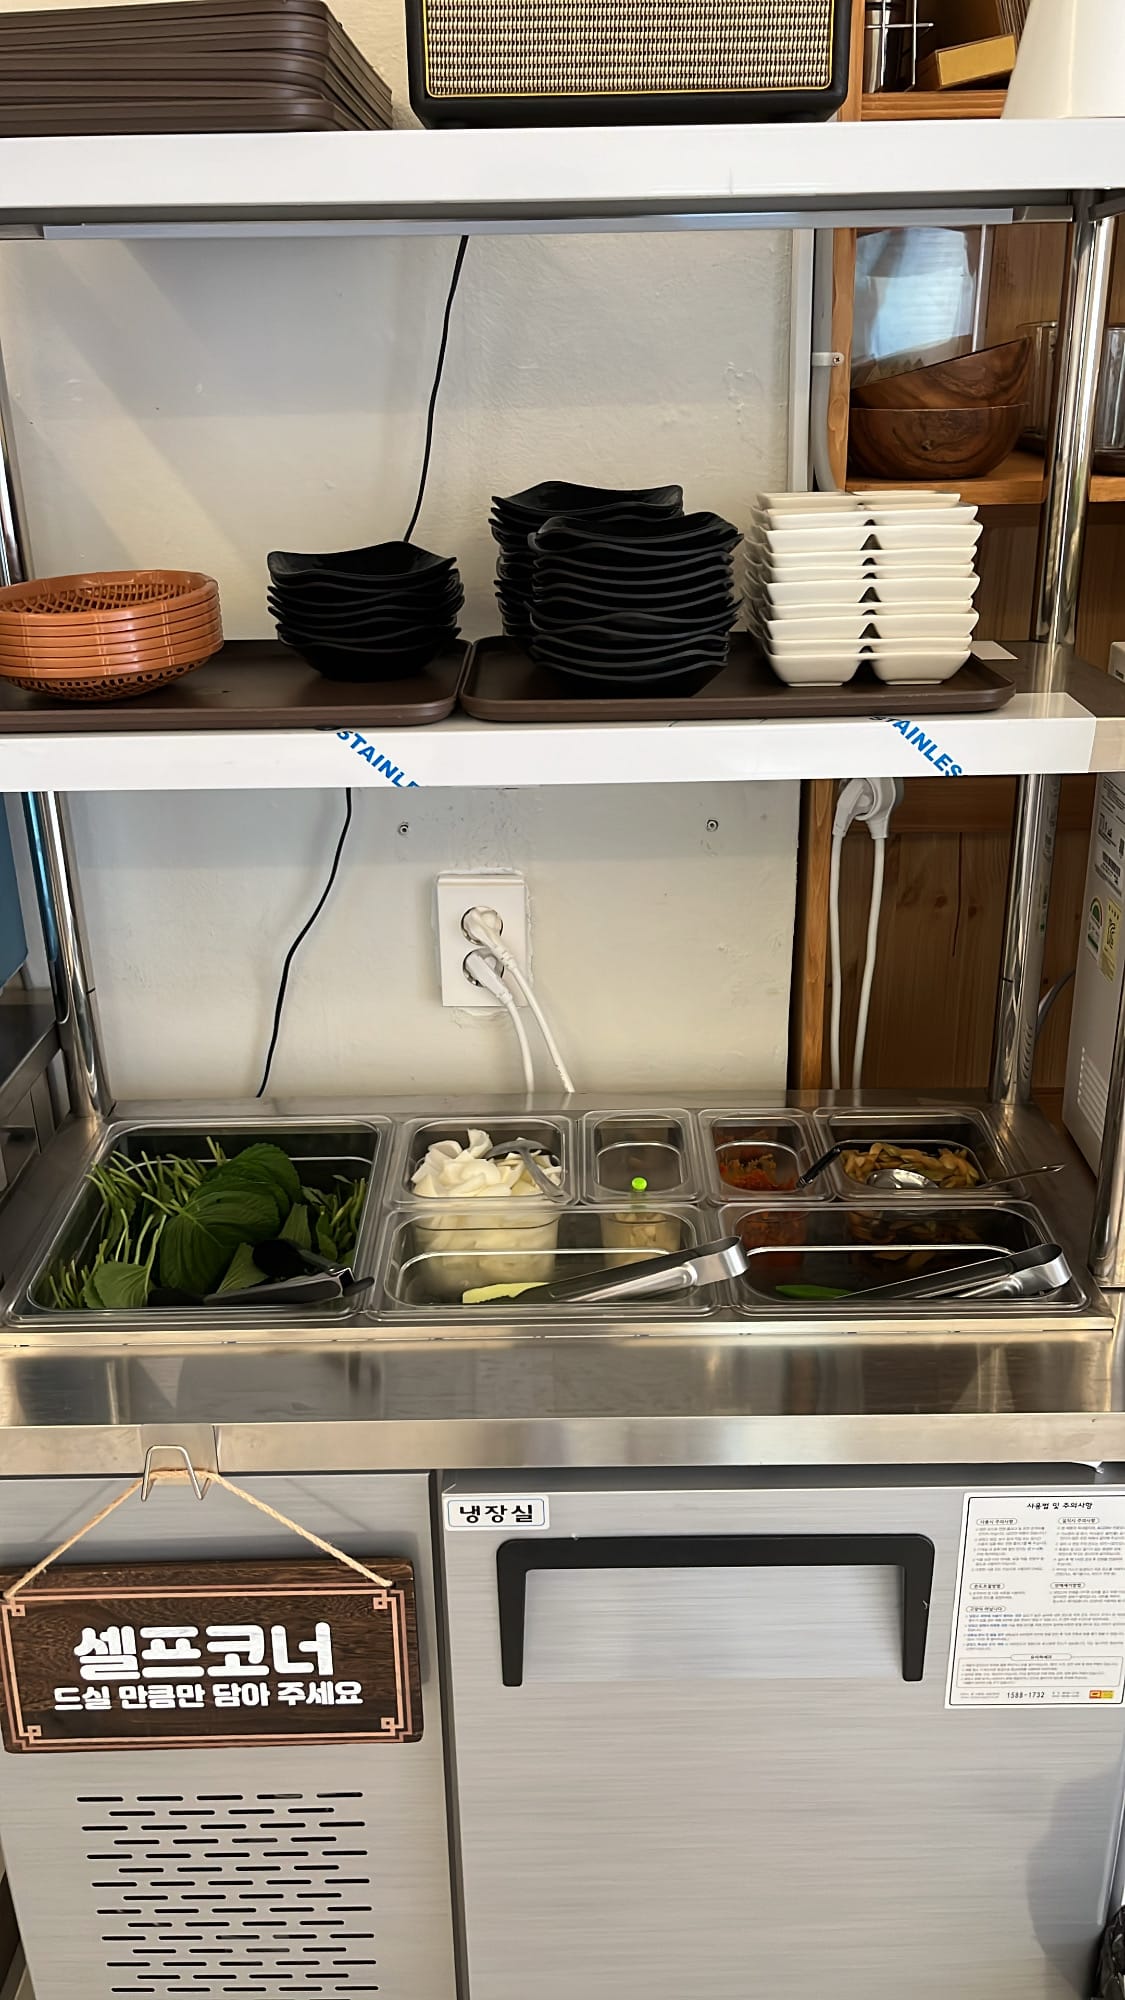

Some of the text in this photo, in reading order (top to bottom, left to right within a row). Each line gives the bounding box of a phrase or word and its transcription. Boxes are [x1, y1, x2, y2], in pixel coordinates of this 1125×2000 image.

[869, 716, 963, 777] AINLES
[459, 1504, 532, 1524] 냉장실
[1026, 1501, 1094, 1511] 사용법 및 주의사항
[73, 1622, 334, 1681] 셀프코너
[54, 1681, 364, 1711] 드실 만큼만 담아 주세요
